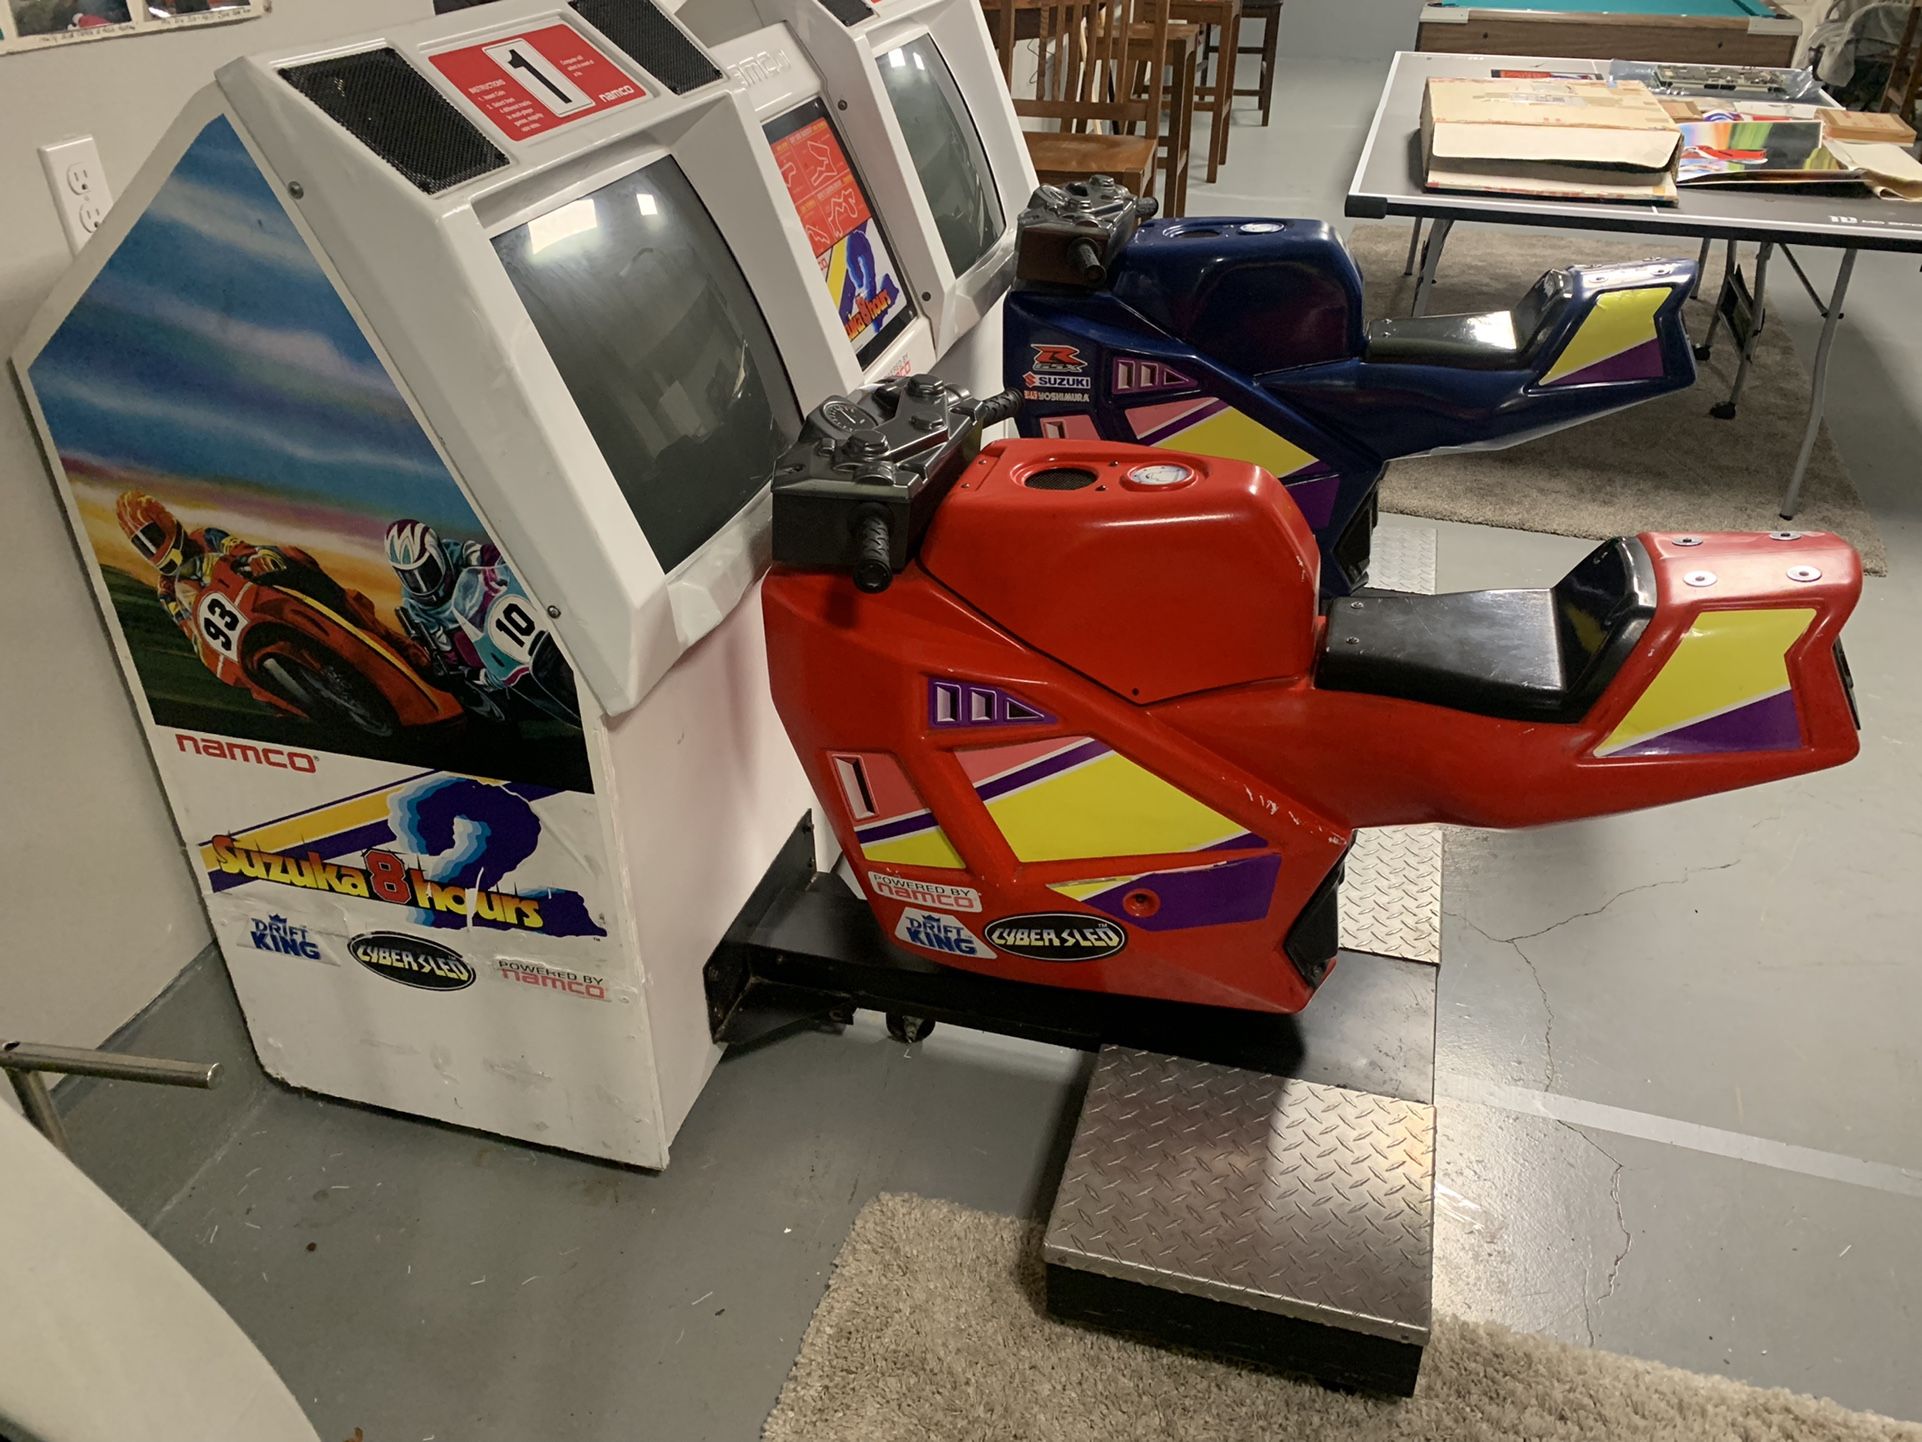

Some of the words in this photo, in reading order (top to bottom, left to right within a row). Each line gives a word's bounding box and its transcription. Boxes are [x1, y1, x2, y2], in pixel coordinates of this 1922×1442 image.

[507, 49, 573, 104] 1
[598, 85, 635, 103] namco
[1038, 376, 1090, 388] SUZUKI
[1038, 391, 1090, 402] YOSHIMURA
[203, 598, 240, 652] 93
[495, 603, 536, 648] 10
[175, 733, 317, 774] namco
[211, 834, 370, 898] Suzuka
[364, 849, 412, 905] 8
[410, 868, 544, 928] hours
[873, 873, 946, 894] POWERED
[951, 888, 971, 897] BY
[876, 881, 975, 909] namco
[251, 917, 308, 941] DRIFT
[904, 916, 964, 938] DRIFT
[905, 926, 978, 956] KING
[990, 928, 1061, 946] CYBER
[1060, 928, 1120, 947] SLED
[250, 931, 321, 960] KING
[357, 944, 420, 971] CYBER
[417, 954, 469, 981] SLED
[498, 960, 578, 981] POWERED
[583, 975, 604, 985] BY
[500, 968, 605, 999] namco
